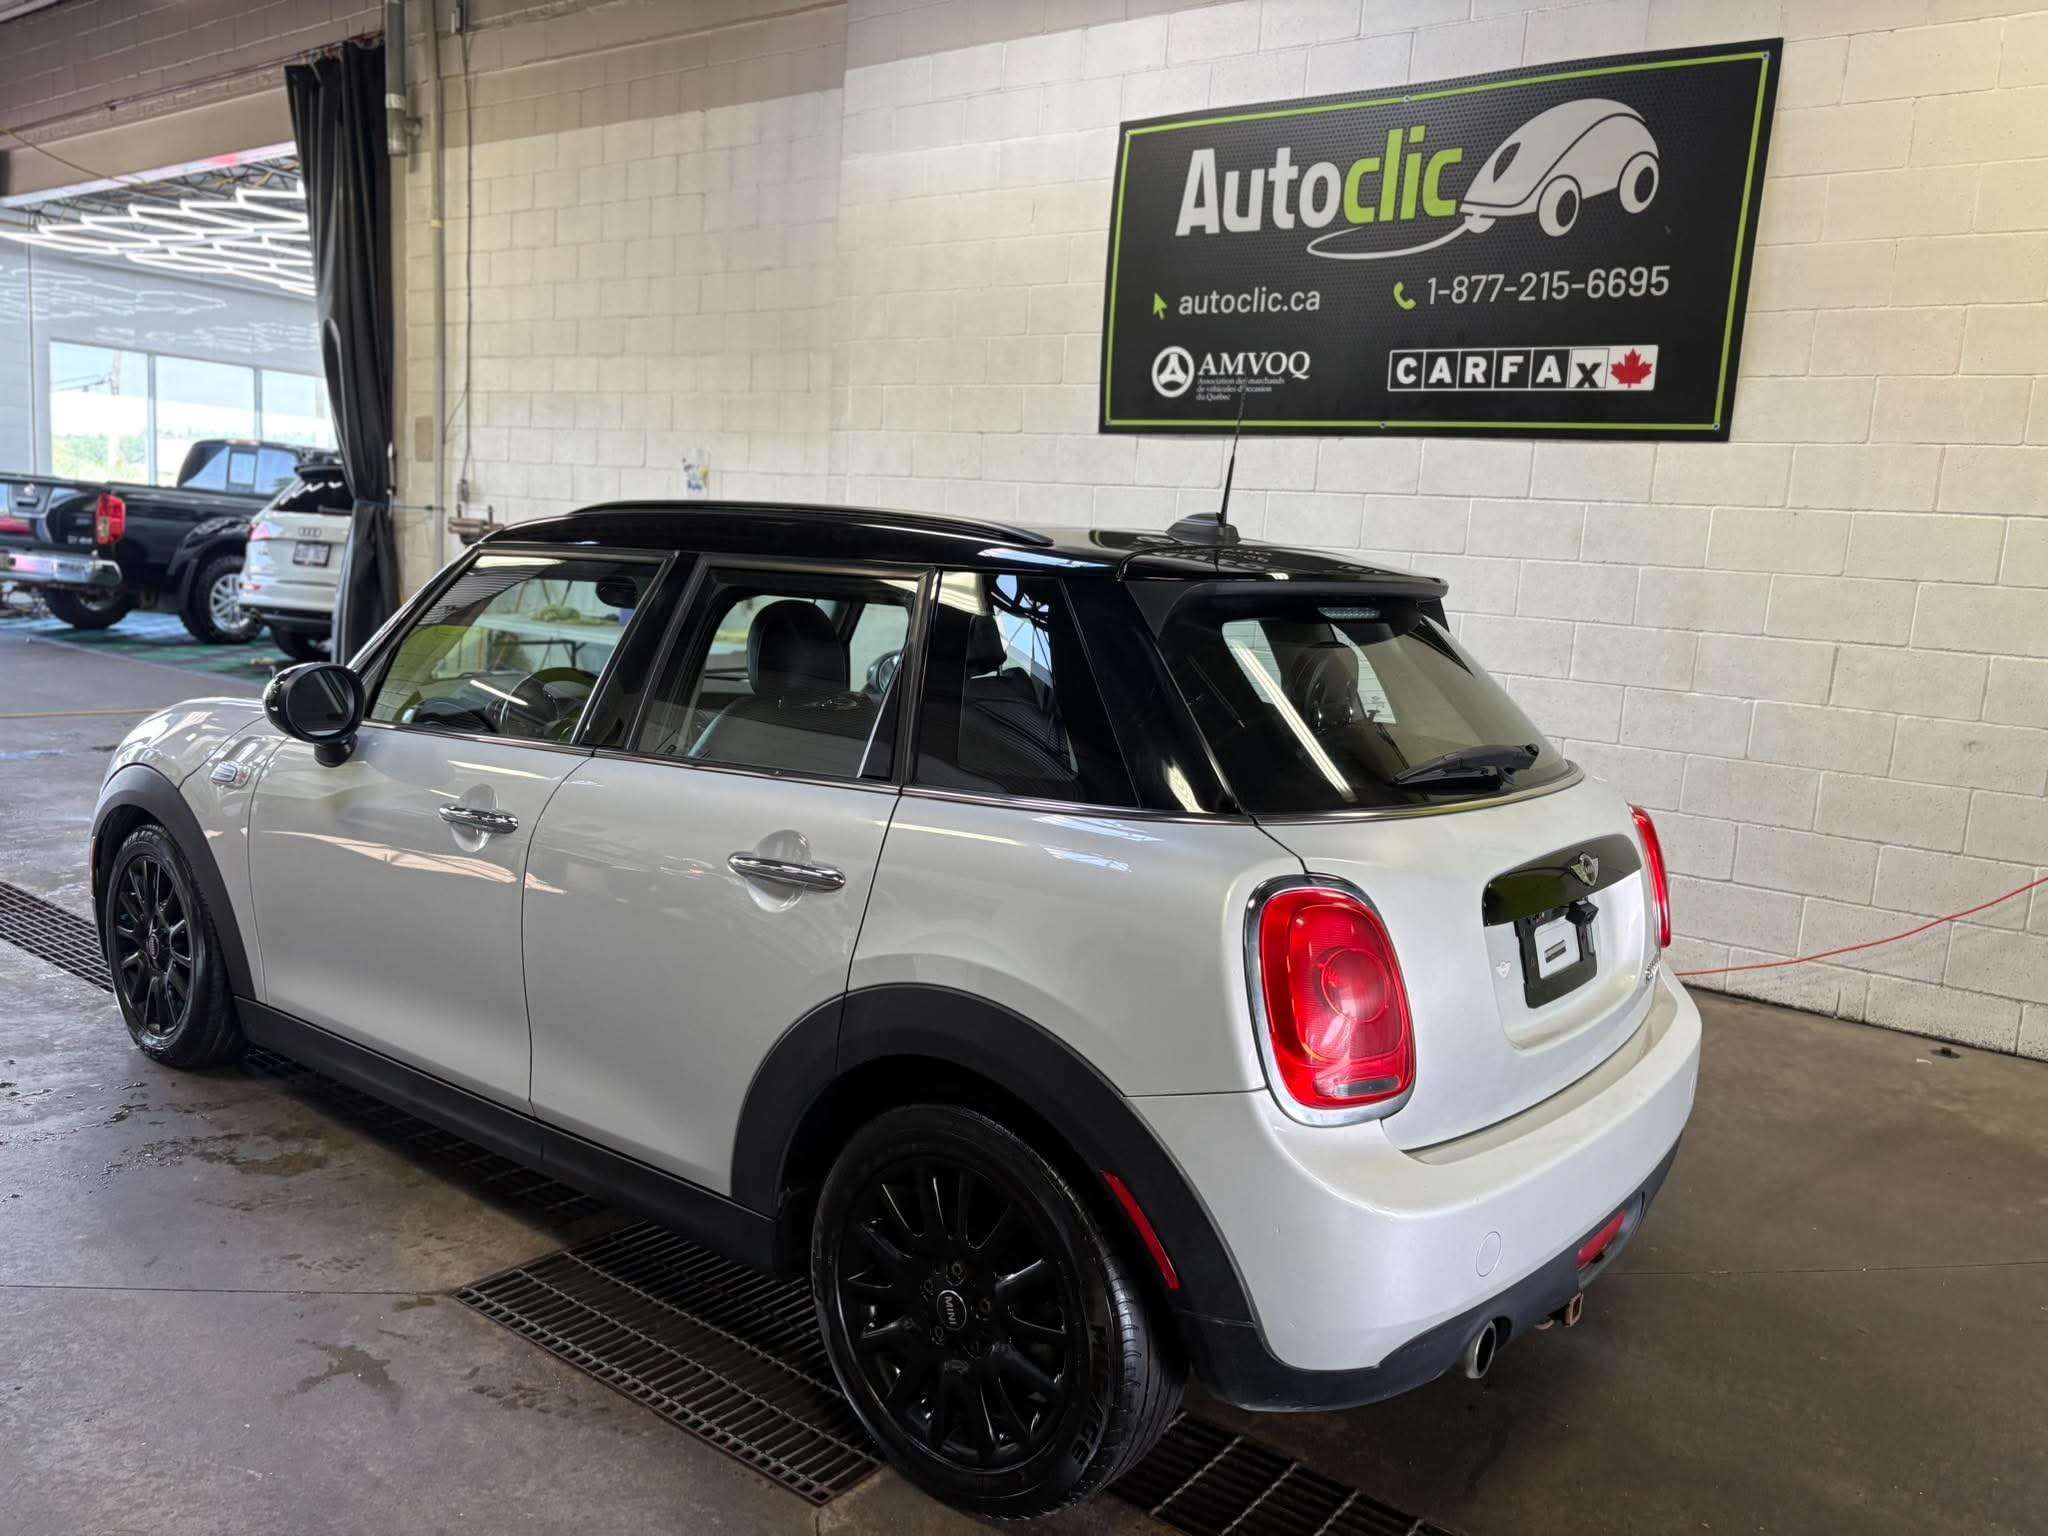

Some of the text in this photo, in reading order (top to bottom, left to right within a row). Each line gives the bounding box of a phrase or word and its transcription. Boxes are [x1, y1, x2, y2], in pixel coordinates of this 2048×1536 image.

[1175, 125, 1463, 237] Autoclic
[1178, 286, 1321, 315] autoclic.ca
[1427, 265, 1670, 305] 1-877-215-6695
[1197, 351, 1311, 380] AMVOQ
[1396, 355, 1602, 389] CARFAX
[943, 1296, 957, 1325] MINI
